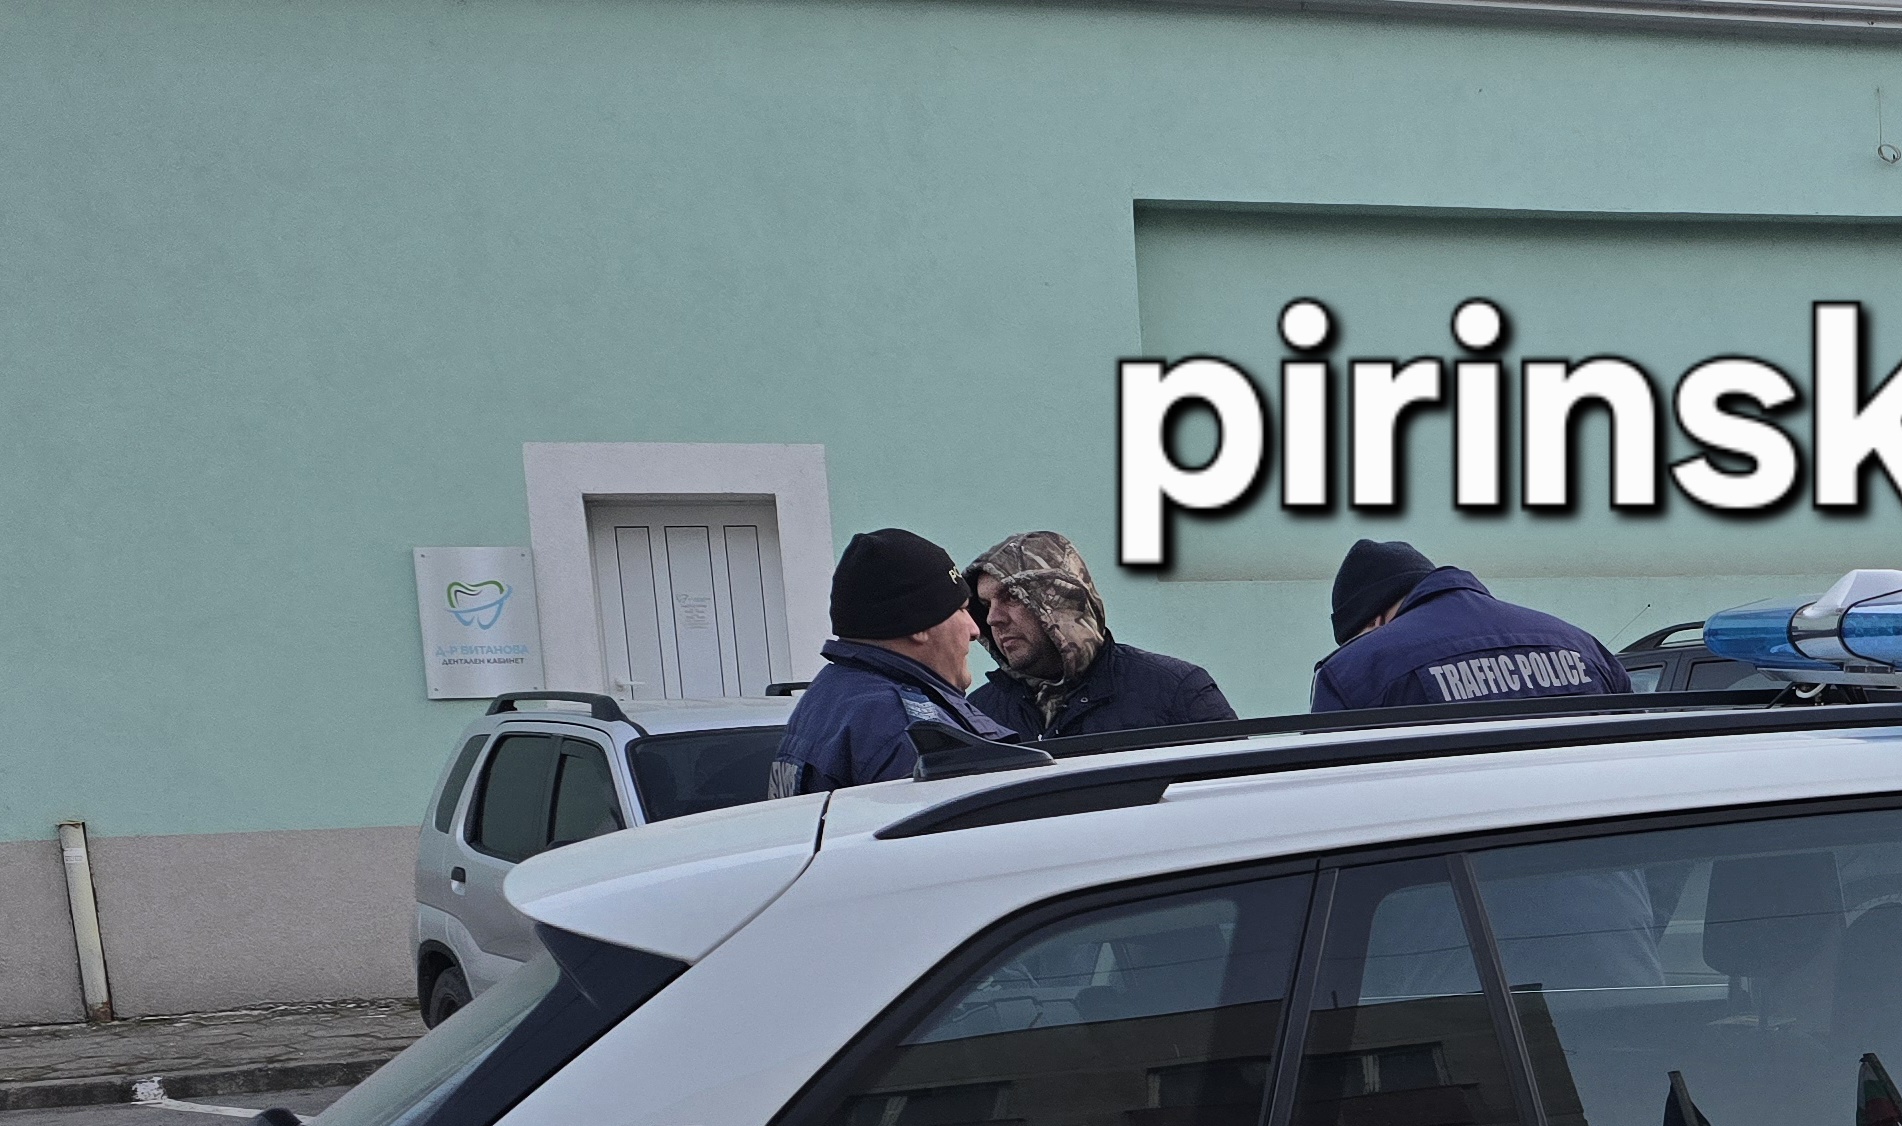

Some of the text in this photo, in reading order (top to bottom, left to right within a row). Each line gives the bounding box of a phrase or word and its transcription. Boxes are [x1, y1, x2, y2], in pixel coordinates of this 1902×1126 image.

[442, 657, 524, 666] ДЕНТАЛЕН КАБИНЕТ
[1428, 649, 1592, 702] TRAFFIC POLICE
